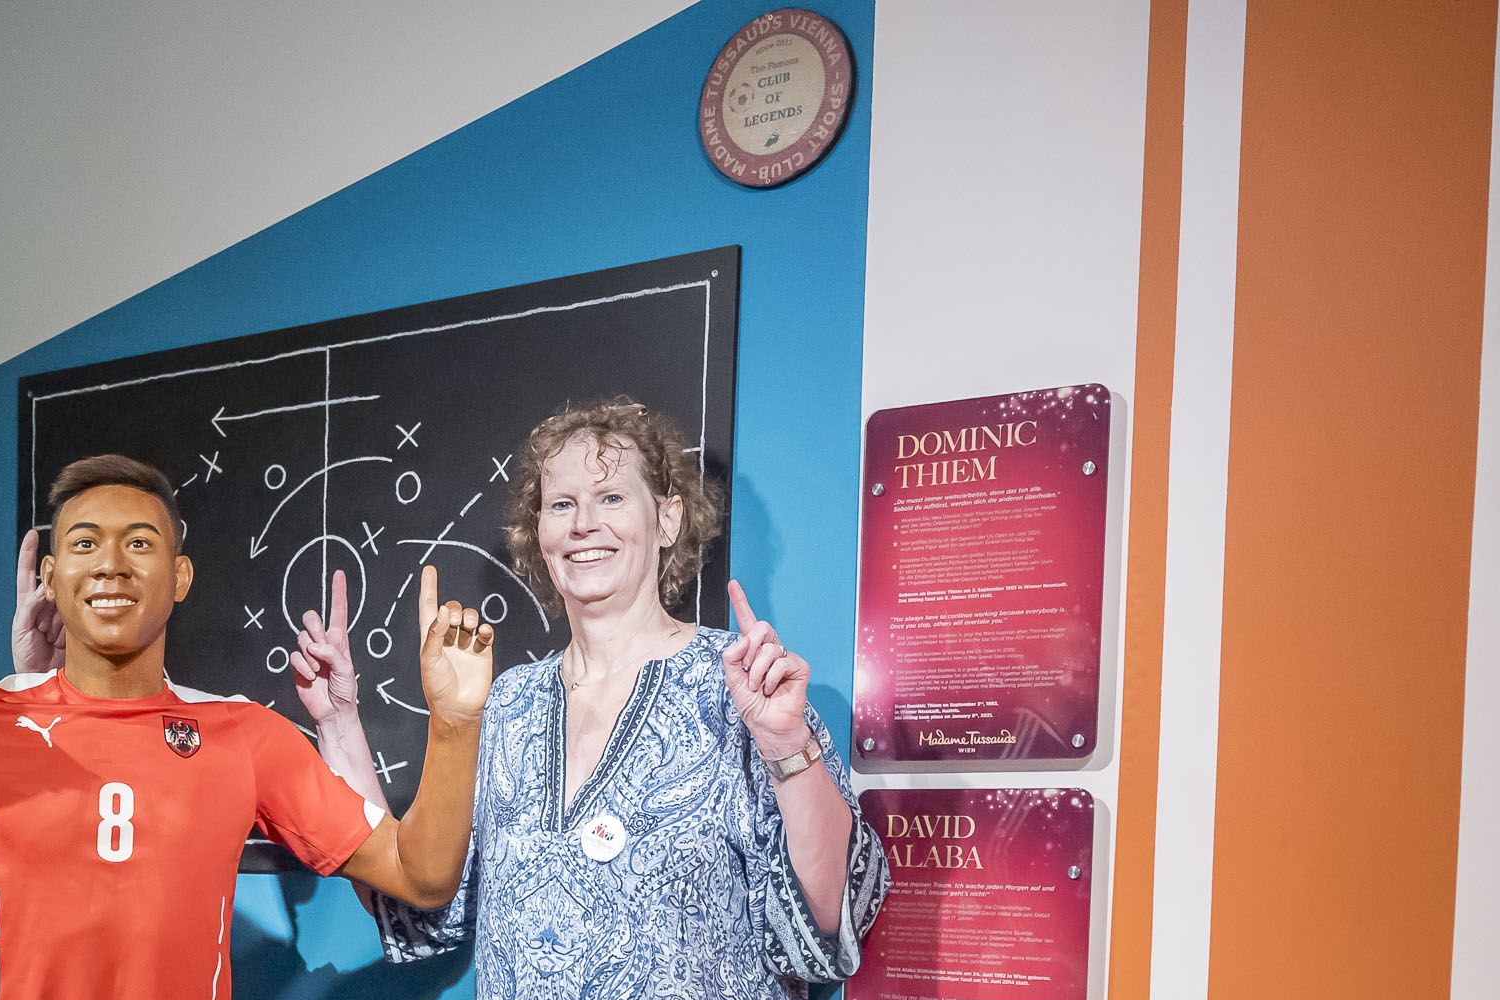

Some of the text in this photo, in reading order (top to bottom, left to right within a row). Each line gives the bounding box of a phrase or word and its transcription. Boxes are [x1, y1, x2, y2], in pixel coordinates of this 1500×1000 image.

[750, 58, 800, 74] The Famous
[758, 72, 790, 88] CLUB
[704, 14, 844, 180] MADAME TUSSAUDS VIENNA SPORT CLUB
[764, 92, 782, 104] OF
[744, 105, 803, 128] LEGENDS
[897, 421, 1038, 460] DOMINIC
[894, 456, 997, 490] THIEM
[919, 729, 1017, 746] Madame Tussauds
[96, 780, 135, 864] 8
[886, 814, 976, 839] DAVID
[886, 844, 984, 870] ALABA
